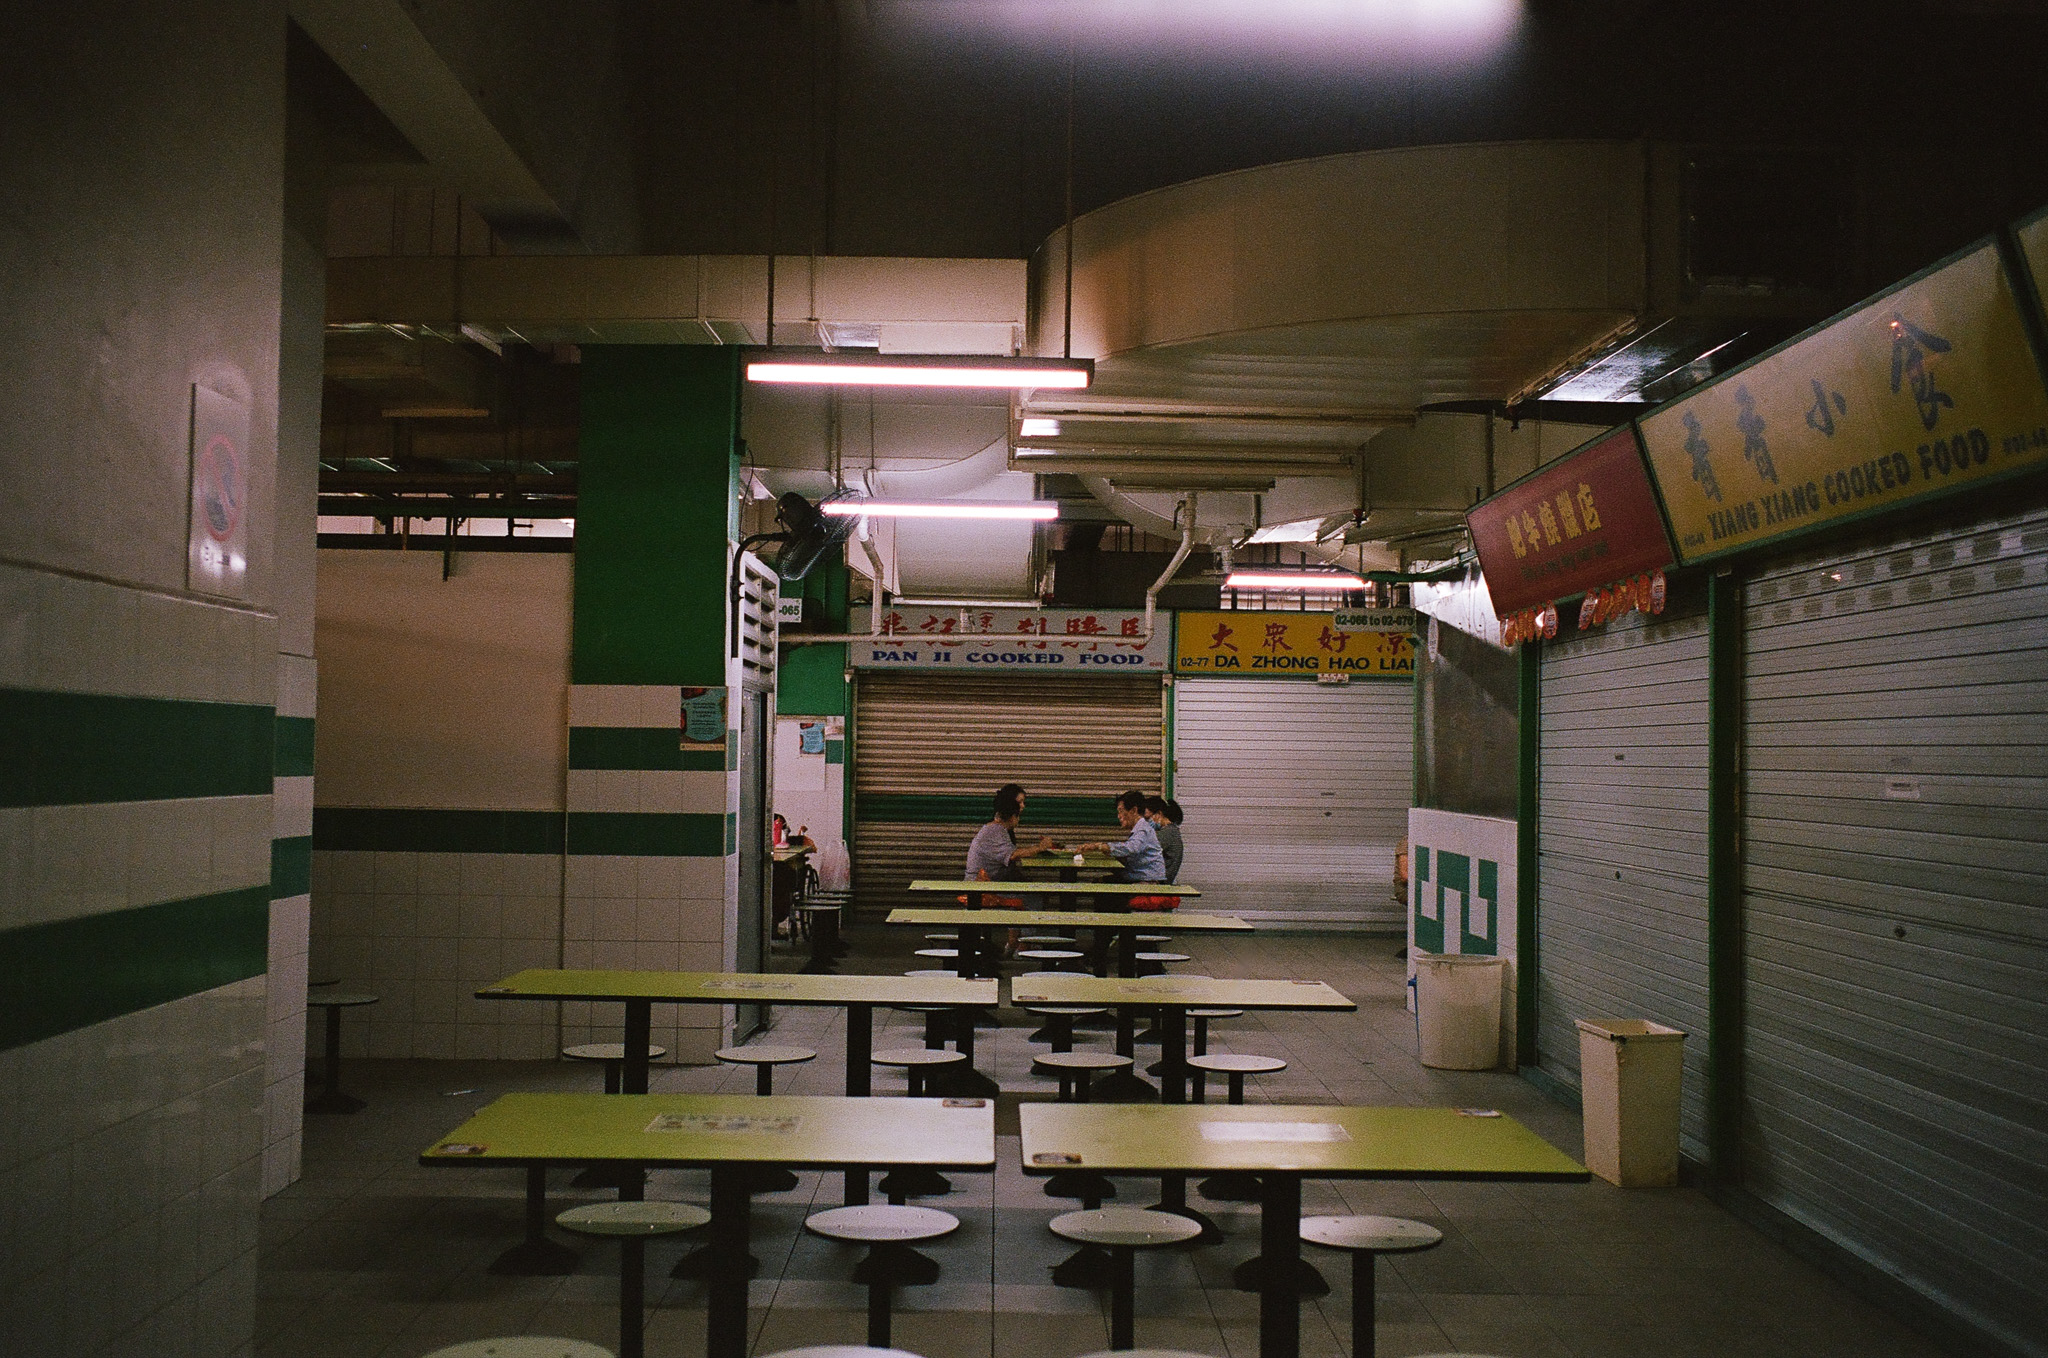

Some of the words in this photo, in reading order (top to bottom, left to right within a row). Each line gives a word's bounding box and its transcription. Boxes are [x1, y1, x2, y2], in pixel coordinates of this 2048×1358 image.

[1707, 501, 1759, 540] XIANG
[1760, 482, 1821, 525] XIANG
[1824, 452, 1911, 506] COOKED
[1916, 428, 1991, 480] FOOD
[1370, 615, 1380, 626] to
[872, 650, 918, 662] PAN
[933, 651, 951, 662] JI
[966, 652, 1063, 664] COOKED
[1079, 654, 1144, 665] FOOD
[1181, 657, 1209, 667] 02-77
[1215, 655, 1240, 668] DA
[1252, 656, 1319, 669] ZHONG
[1329, 657, 1370, 670] HAO
